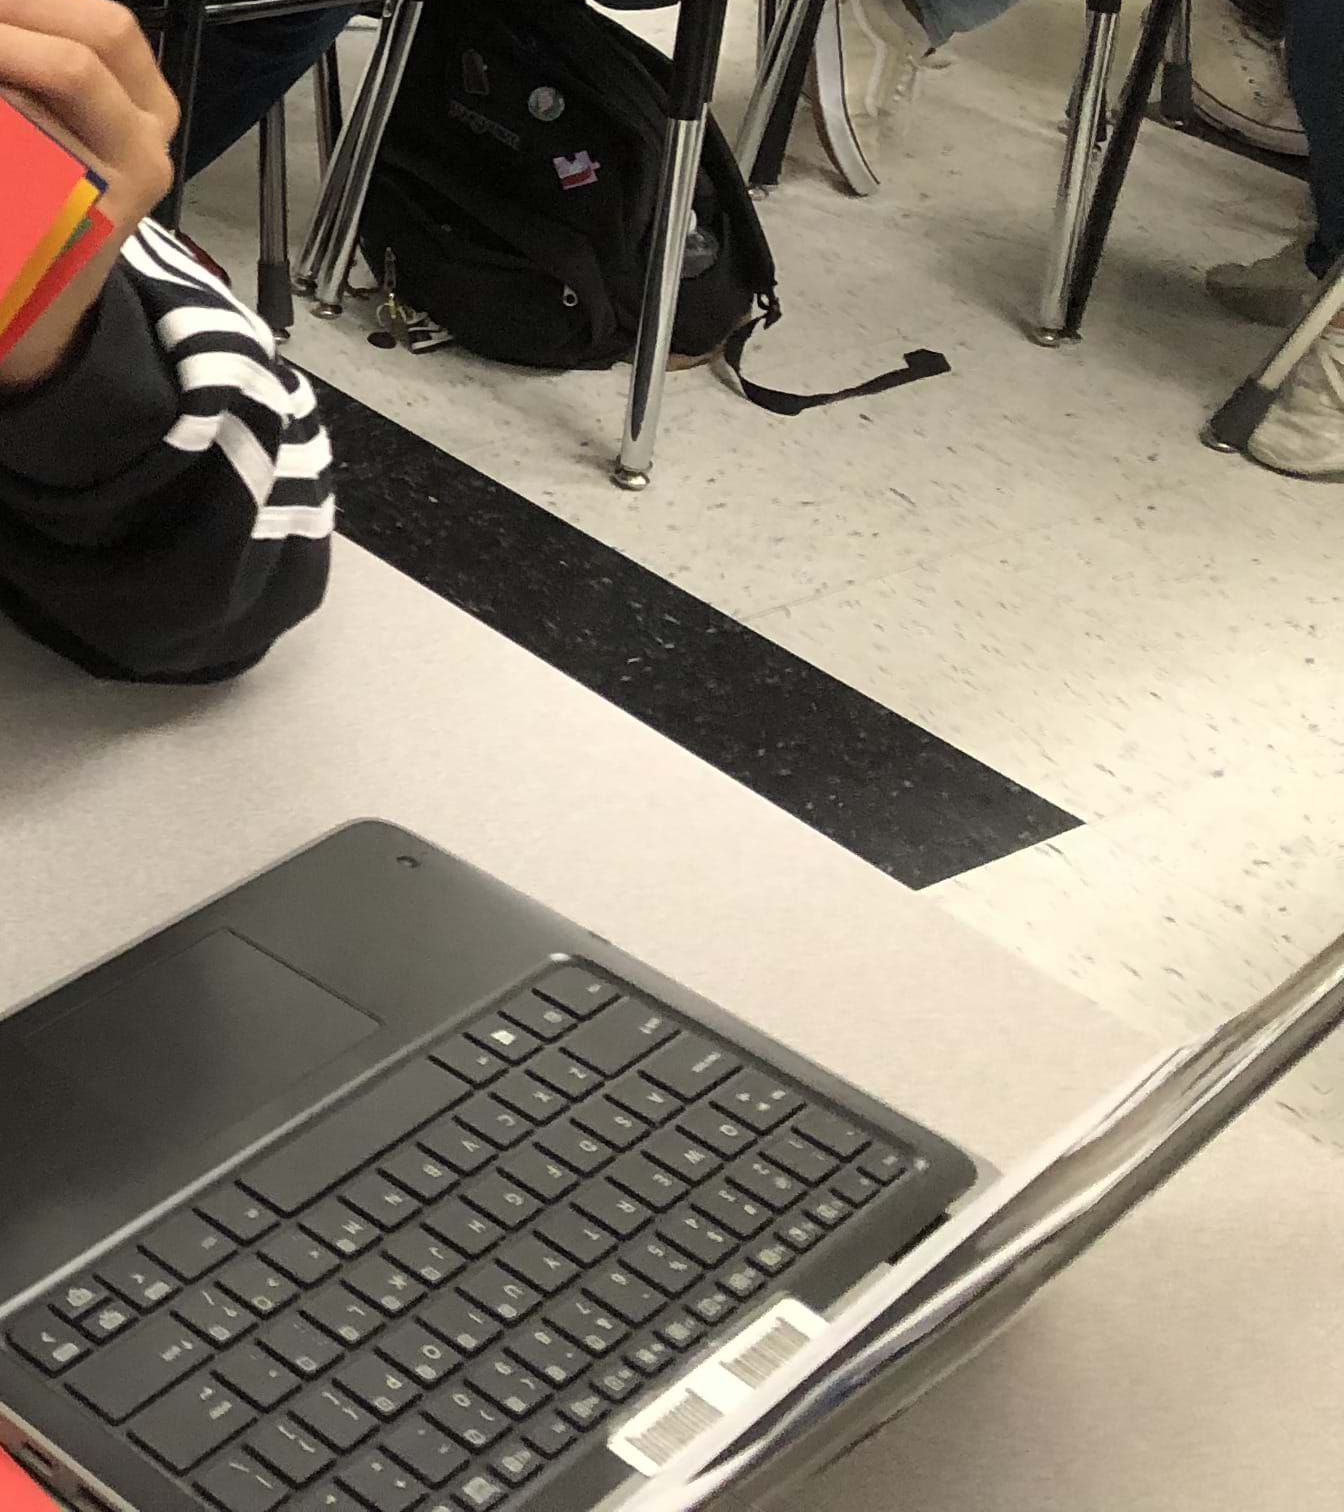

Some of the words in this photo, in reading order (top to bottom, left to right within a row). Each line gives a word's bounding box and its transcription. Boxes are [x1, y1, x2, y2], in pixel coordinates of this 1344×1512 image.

[343, 1221, 363, 1234] M
[469, 1220, 485, 1232] H
[429, 1247, 443, 1259] J
[389, 1275, 406, 1289] K
[504, 1285, 522, 1298] U
[386, 1375, 402, 1389] P
